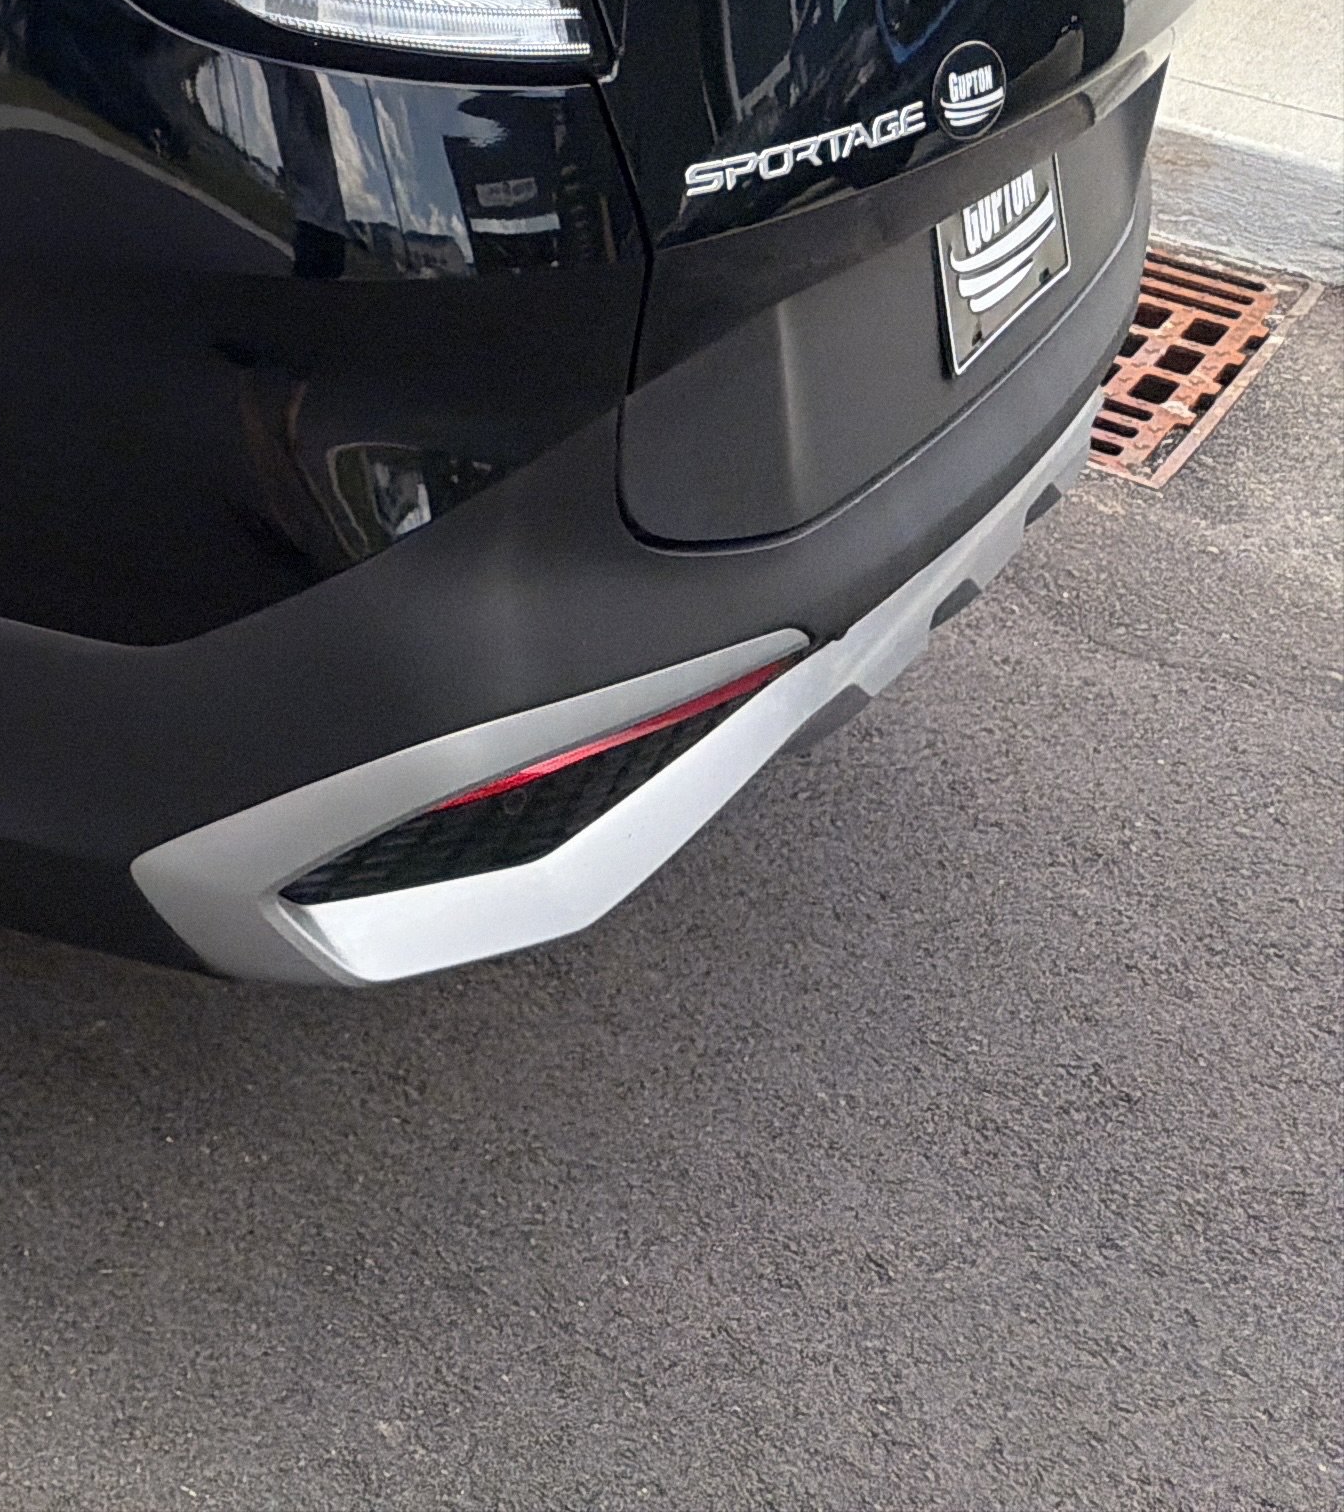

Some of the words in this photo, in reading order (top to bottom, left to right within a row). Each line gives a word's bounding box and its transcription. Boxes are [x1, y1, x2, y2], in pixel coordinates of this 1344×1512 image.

[948, 65, 994, 102] GUPTON
[685, 101, 927, 196] SPORTAGE
[962, 168, 1036, 255] GUPTON
